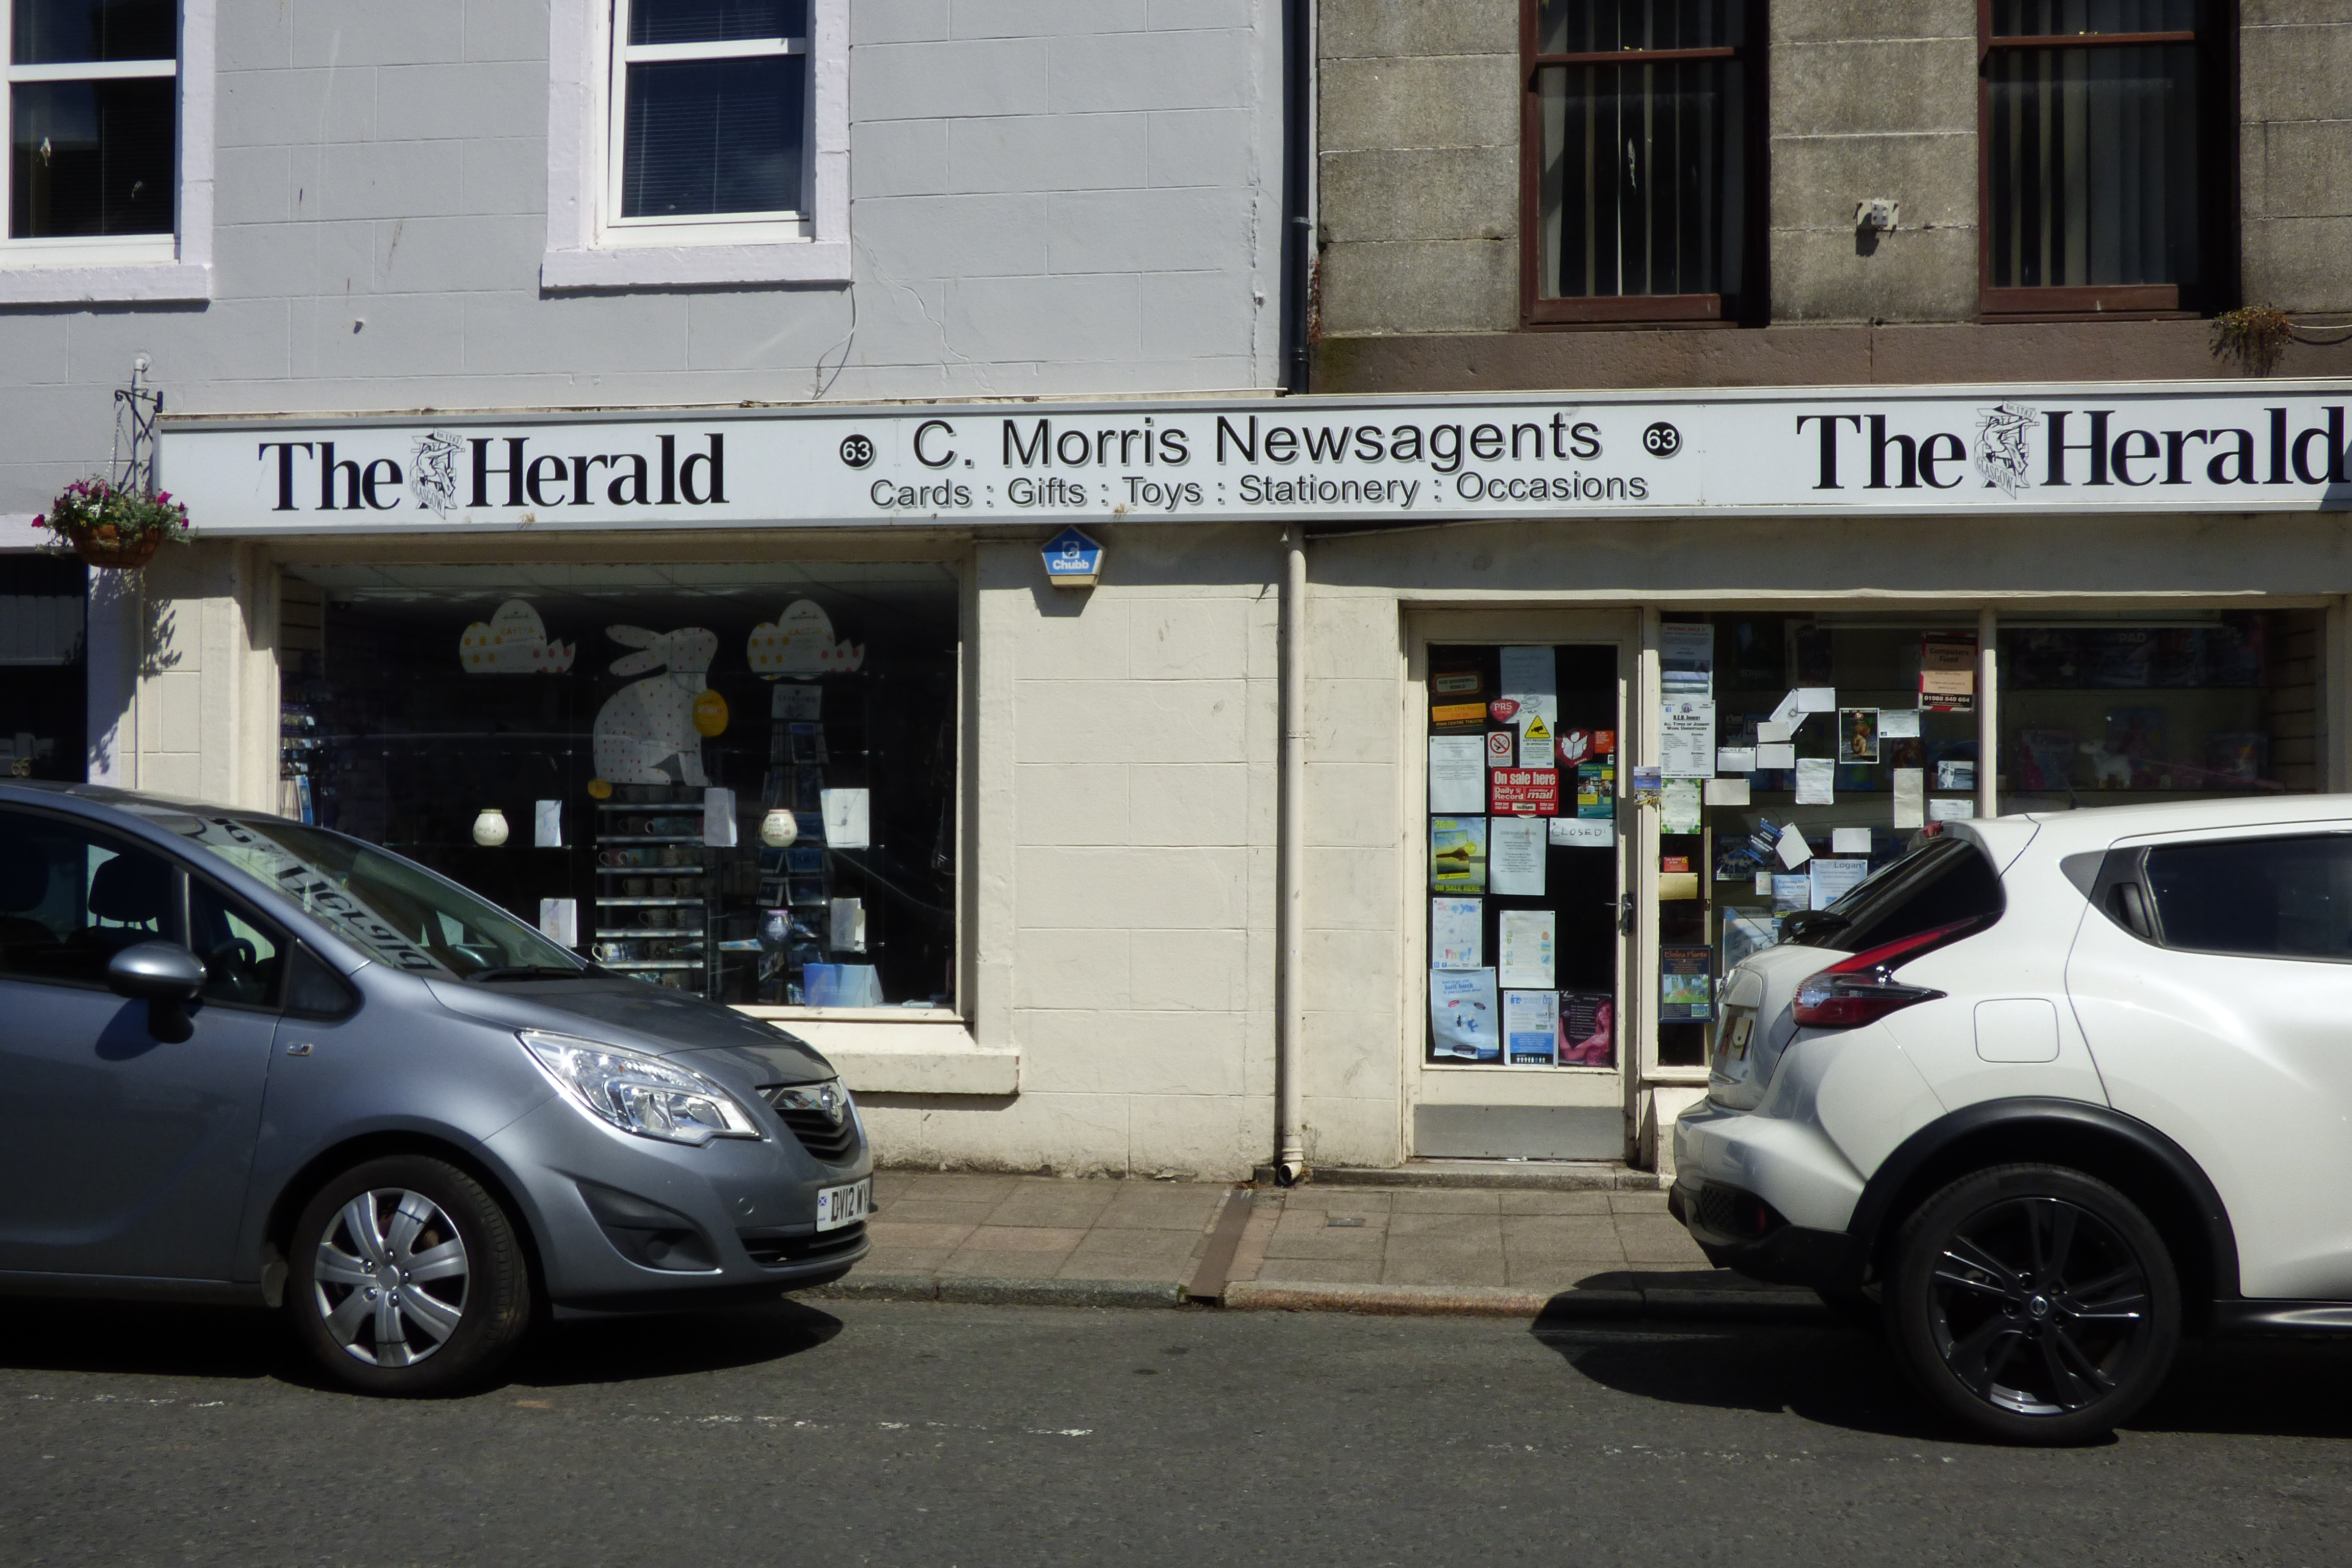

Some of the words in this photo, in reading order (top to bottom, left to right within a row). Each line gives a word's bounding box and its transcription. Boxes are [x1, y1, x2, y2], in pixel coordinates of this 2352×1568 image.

[2017, 406, 2033, 418] 1783
[445, 434, 460, 445] 1783
[914, 420, 971, 467] C.
[1000, 414, 1187, 464] Morris
[1213, 410, 1600, 474] Newsagents
[1646, 428, 1678, 450] 63
[1797, 414, 1966, 489] The
[2041, 406, 2352, 488] Herald
[843, 440, 873, 462] 63
[259, 442, 403, 510] The
[467, 433, 729, 507] Herald
[1976, 456, 2013, 492] GLASGOW
[411, 480, 443, 512] GLASGOW
[870, 478, 972, 508] Cards
[1007, 477, 1086, 507] Gifts
[1122, 475, 1203, 512] Toys
[1239, 474, 1420, 510] Stationery
[1456, 471, 1649, 502] Occasions
[1052, 559, 1090, 570] Chubb
[1494, 702, 1513, 710] PRS
[11, 758, 31, 777] 65
[1494, 771, 1508, 785] On
[1510, 771, 1531, 785] sale
[1533, 771, 1556, 786] here
[1527, 789, 1554, 799] mail
[1434, 820, 1458, 829] 2020
[1834, 862, 1861, 870] Logan
[1687, 949, 1707, 958] Plants
[830, 1187, 854, 1222] DV12
